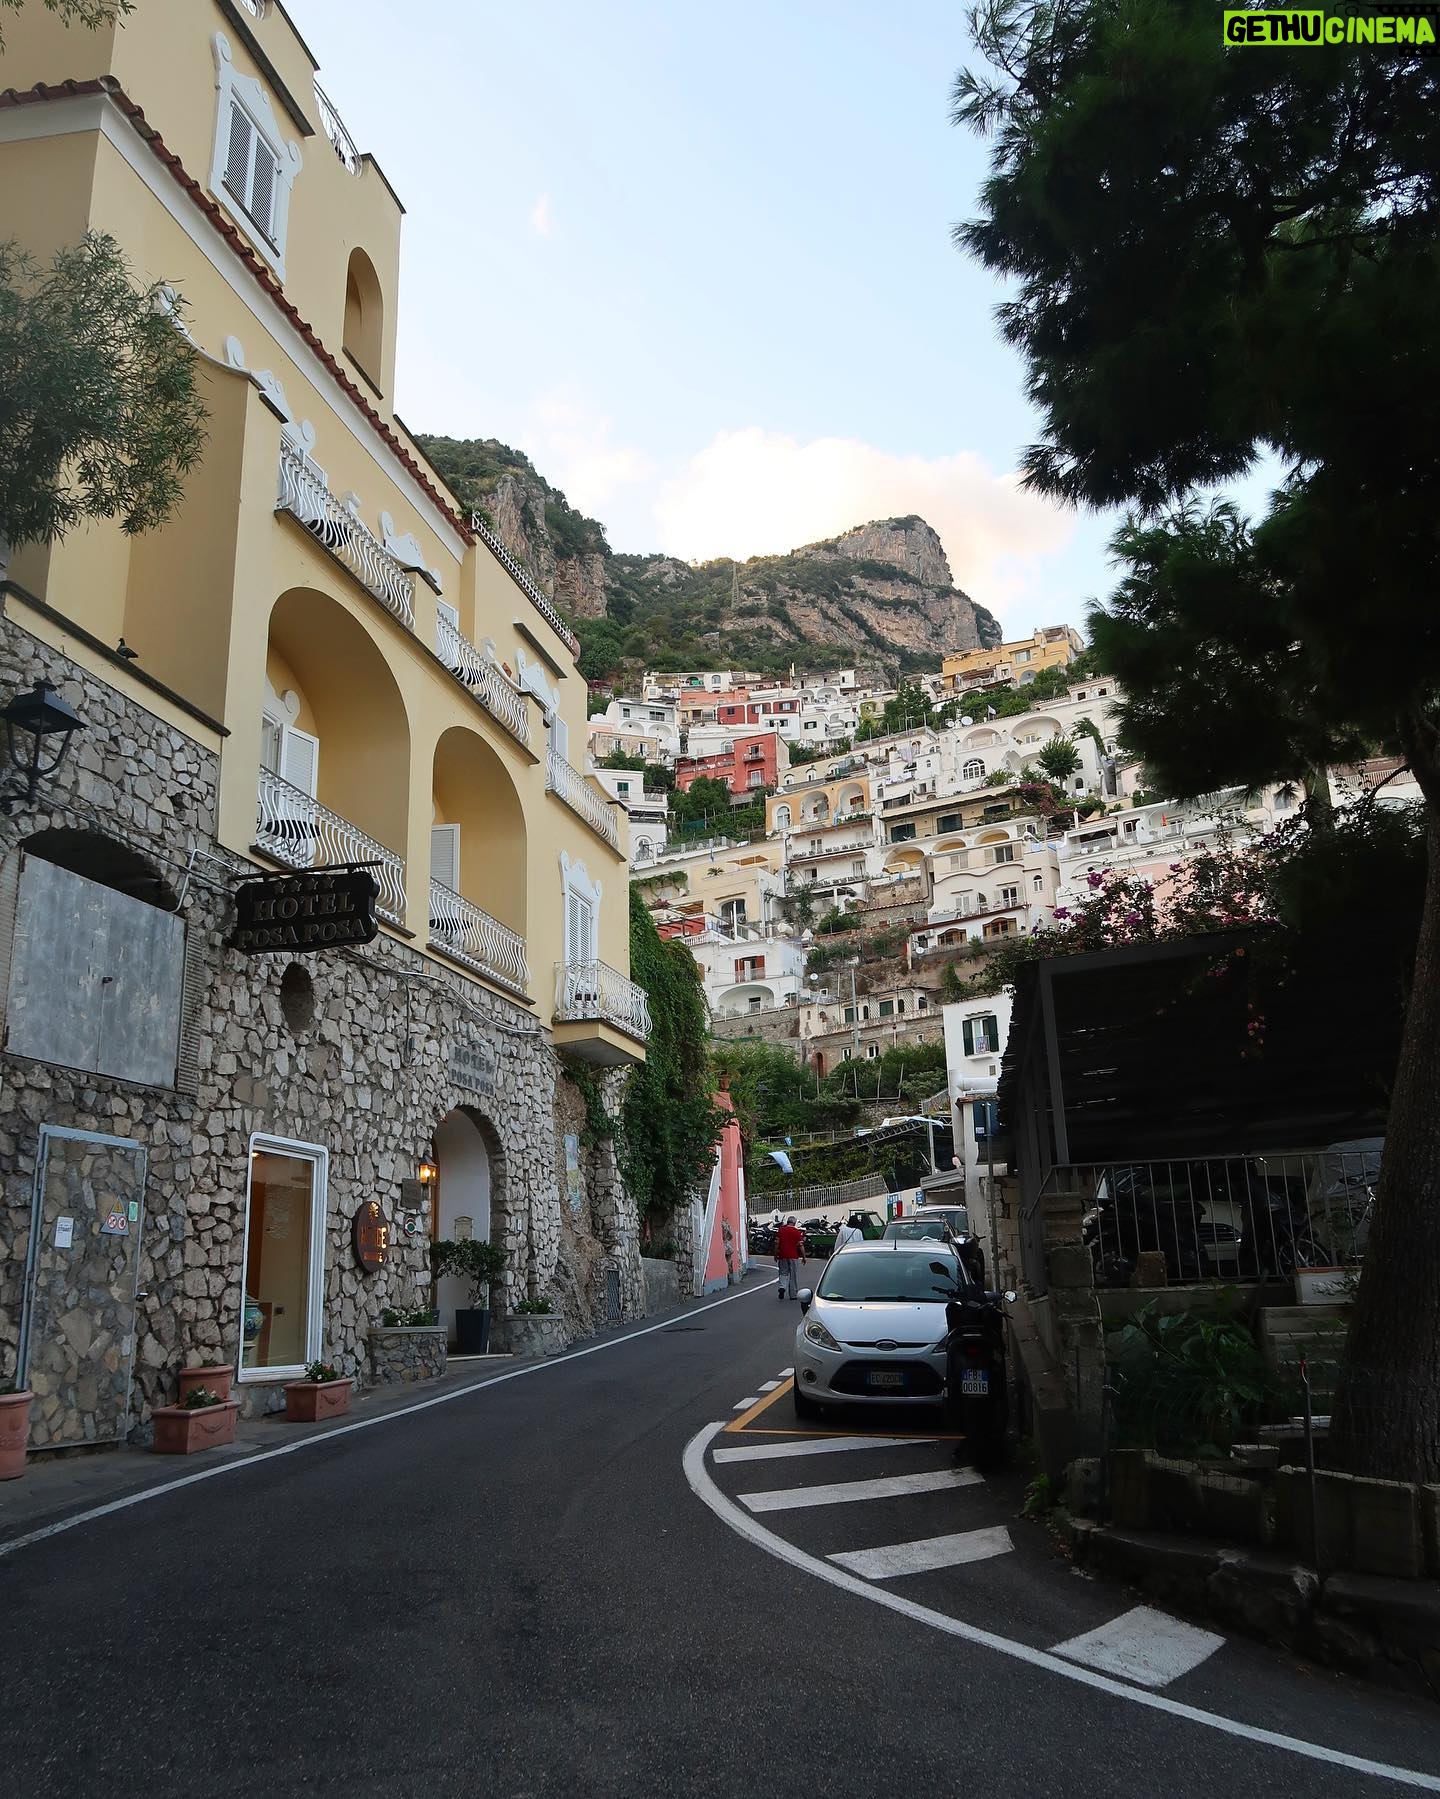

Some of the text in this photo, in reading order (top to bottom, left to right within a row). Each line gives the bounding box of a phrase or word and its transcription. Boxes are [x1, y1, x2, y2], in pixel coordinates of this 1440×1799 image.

[254, 891, 355, 920] HOTEL
[236, 918, 367, 949] POSA POSA
[454, 1046, 494, 1074] HOTEL
[451, 1068, 494, 1096] POSA POSA
